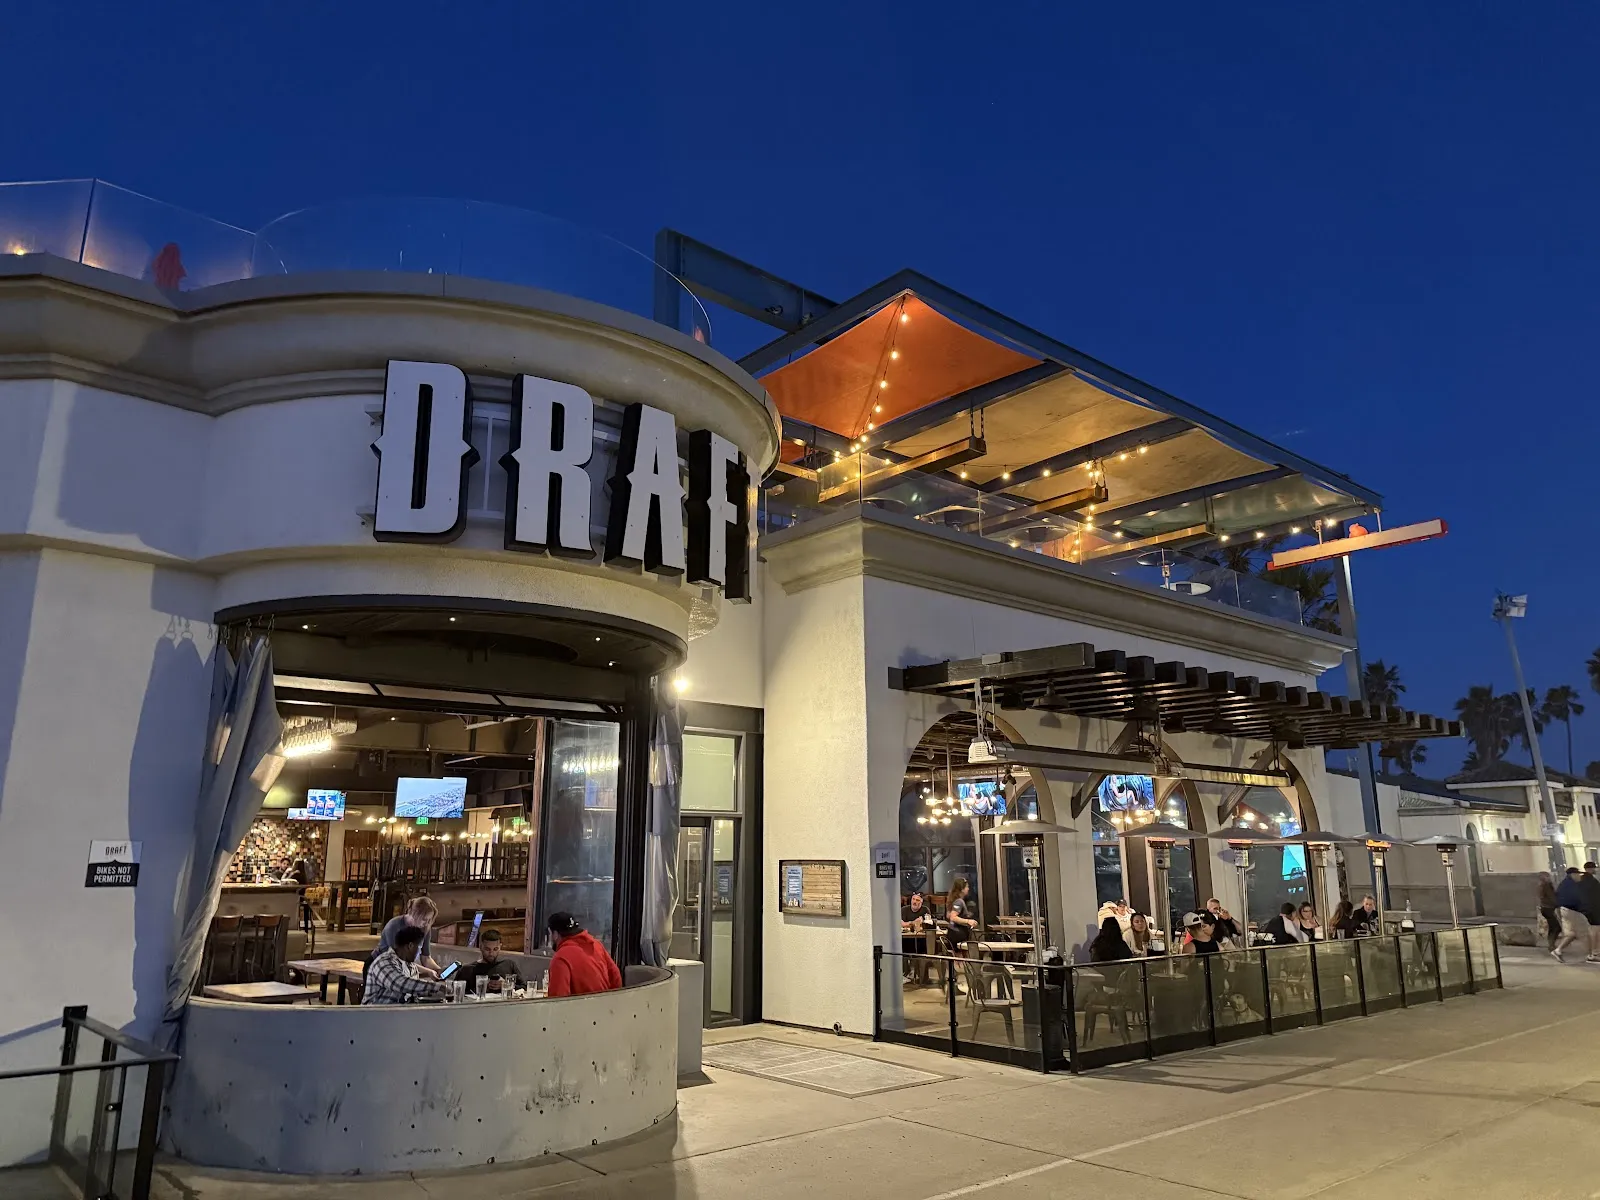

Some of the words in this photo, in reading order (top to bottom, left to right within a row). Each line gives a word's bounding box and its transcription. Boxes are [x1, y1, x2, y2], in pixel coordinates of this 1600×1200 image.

[370, 359, 762, 604] DRAFT
[105, 846, 127, 856] DRAFT
[96, 866, 116, 874] BIKES
[117, 866, 131, 874] NOT
[93, 874, 131, 883] PERMITTED
